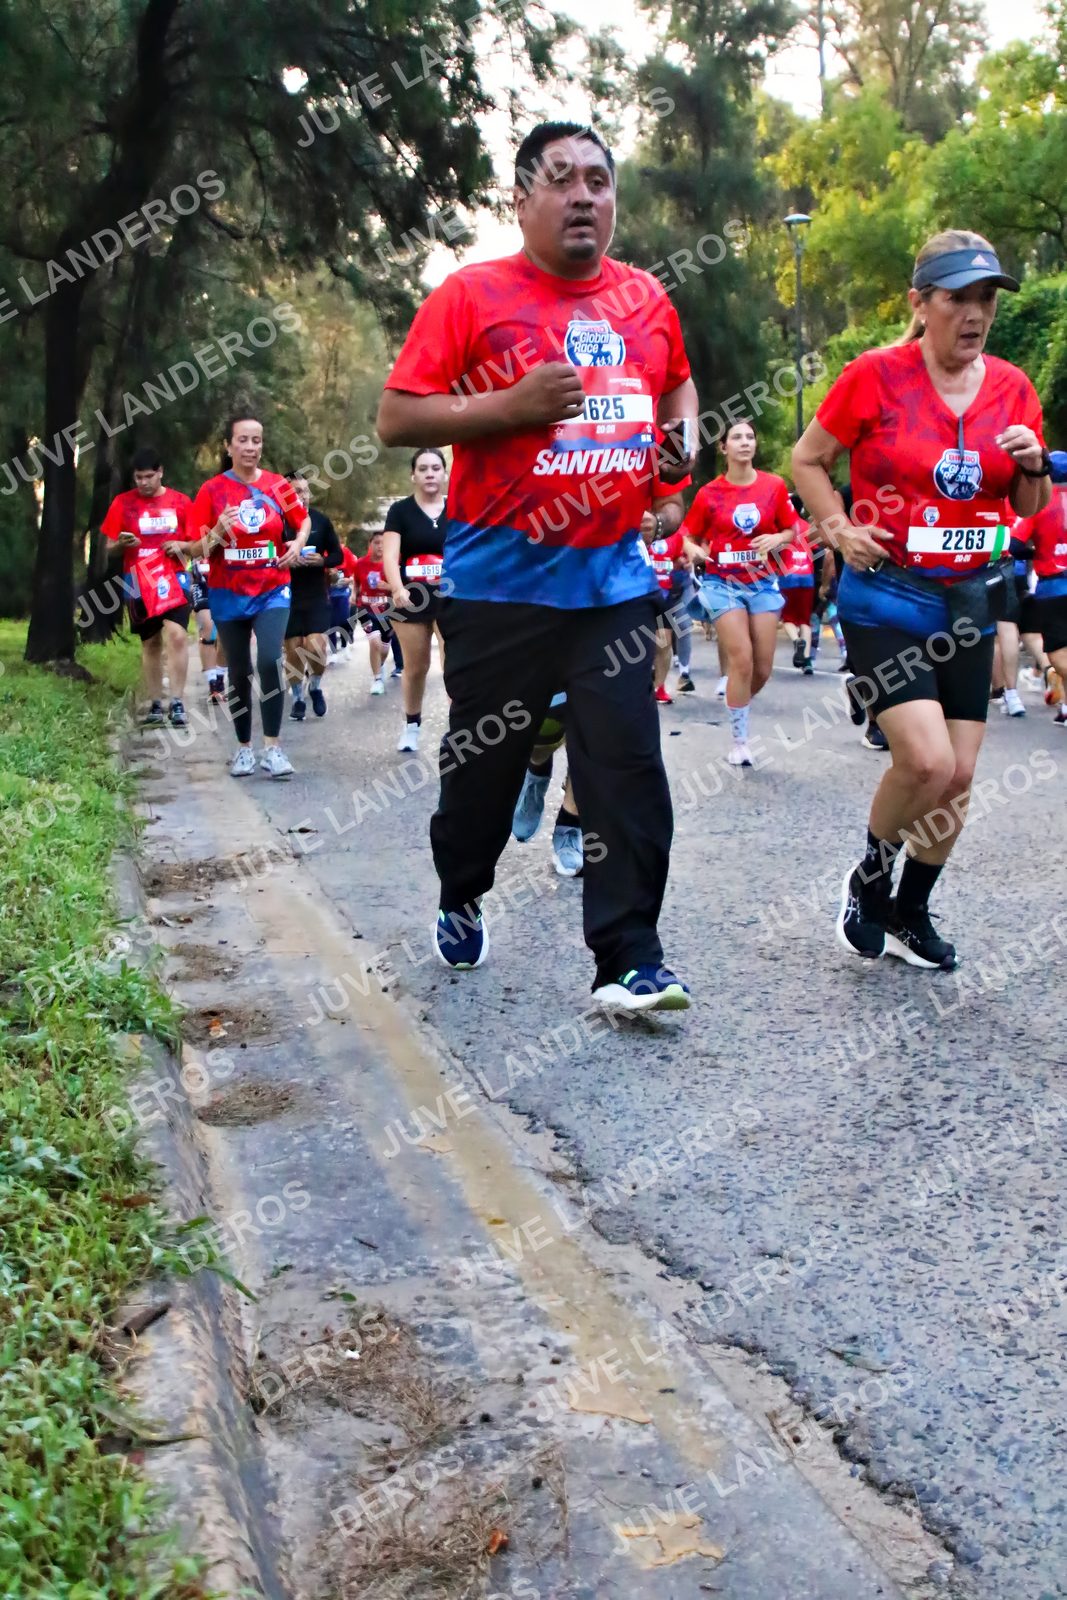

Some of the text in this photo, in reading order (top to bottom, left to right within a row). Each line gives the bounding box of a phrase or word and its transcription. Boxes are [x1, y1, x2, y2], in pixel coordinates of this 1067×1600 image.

[579, 331, 610, 344] Global
[574, 341, 599, 353] Race
[533, 448, 647, 475] SANTIAGO
[942, 529, 986, 551] 2263
[237, 548, 263, 559] 17682
